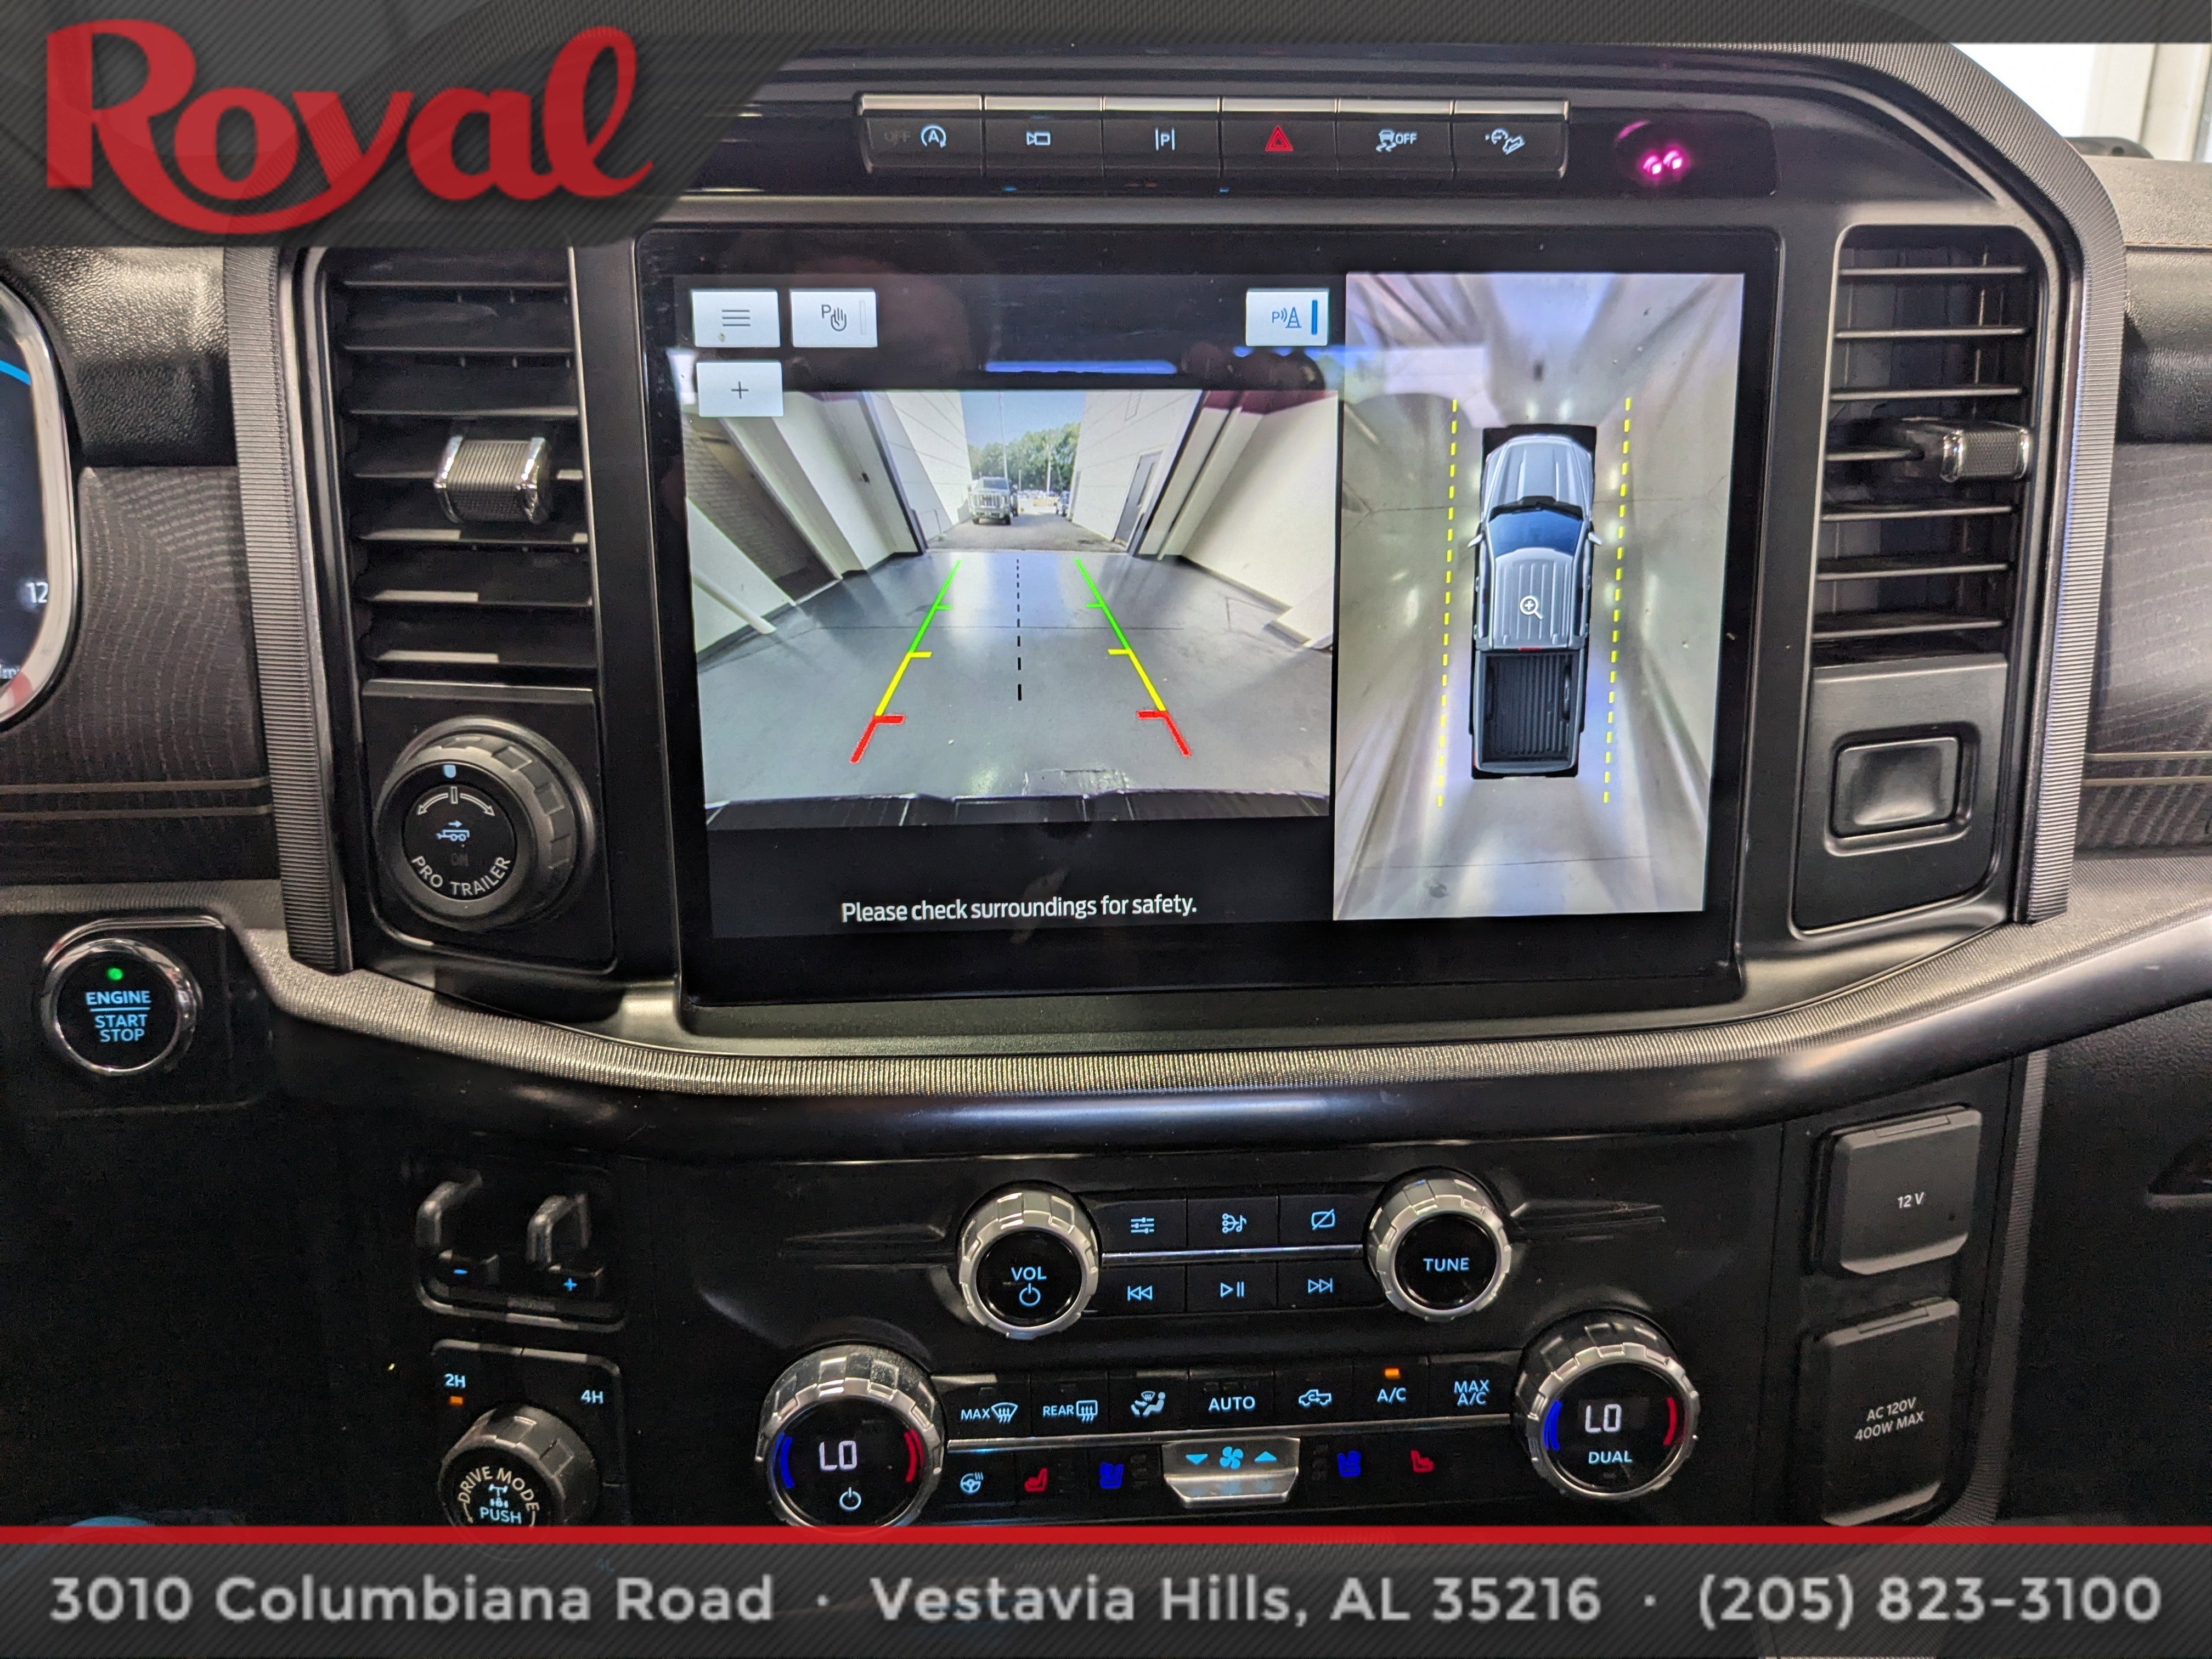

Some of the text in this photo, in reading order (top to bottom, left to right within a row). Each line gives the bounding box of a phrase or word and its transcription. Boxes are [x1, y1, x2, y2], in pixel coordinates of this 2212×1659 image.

[1395, 132, 1417, 145] OFF
[821, 304, 831, 319] P
[1272, 311, 1280, 324] P
[411, 855, 511, 896] PRO TRAILER
[842, 893, 1197, 923] Please check surroundings for safety.
[86, 990, 151, 1006] ENGINE
[95, 1014, 147, 1029] START
[99, 1028, 145, 1043] STOP
[1897, 1192, 1925, 1209] 12 V
[1423, 1256, 1470, 1273] TUNE
[1011, 1266, 1047, 1282] VOL
[444, 1373, 466, 1389] 2H
[1453, 1379, 1490, 1394] MAX
[580, 1389, 604, 1404] 4H
[1376, 1386, 1407, 1403] A/C
[1457, 1392, 1487, 1406] A/C
[1042, 1404, 1075, 1417] REAR
[1207, 1395, 1256, 1412] AUTO
[1866, 1396, 1917, 1422] AC 120V
[961, 1408, 990, 1421] MAX
[1584, 1403, 1622, 1434] LO
[1854, 1410, 1925, 1442] 400W MAX
[819, 1440, 857, 1471] LO
[1588, 1450, 1633, 1465] DUAL
[458, 1465, 540, 1513] DRIVE MODE
[479, 1506, 522, 1525] PUSH
